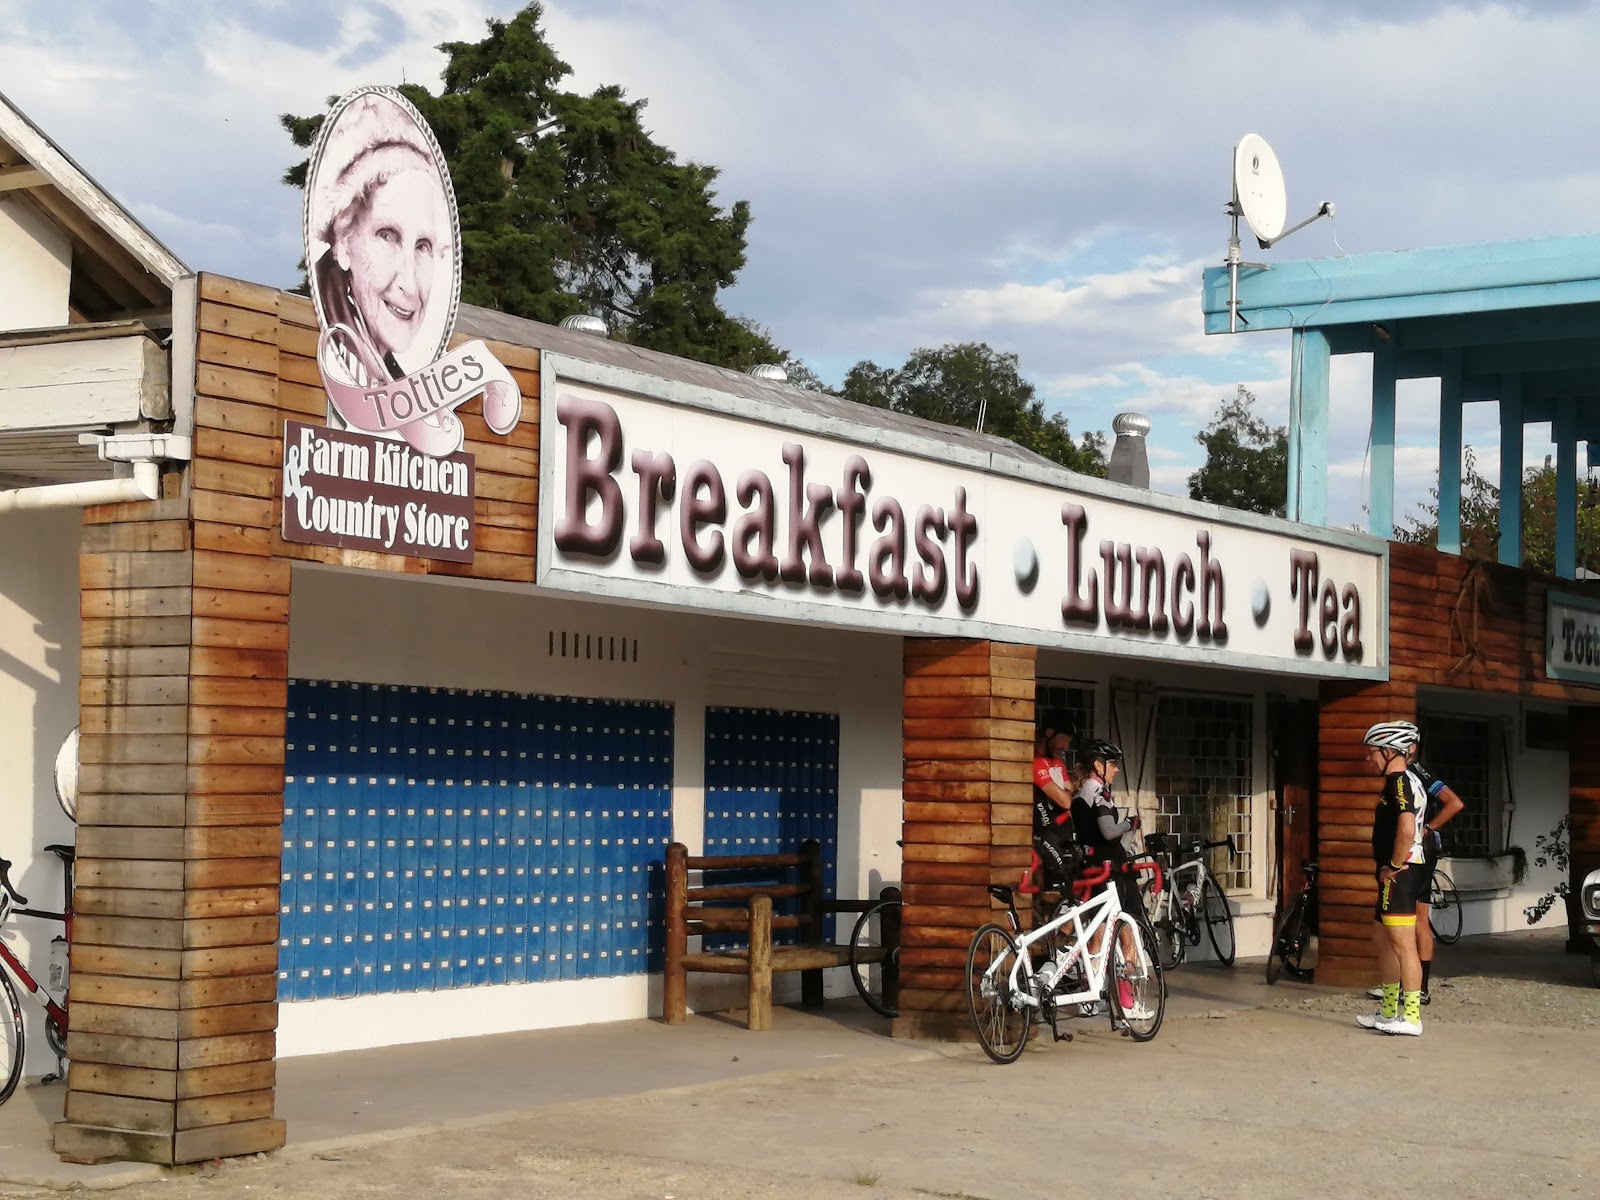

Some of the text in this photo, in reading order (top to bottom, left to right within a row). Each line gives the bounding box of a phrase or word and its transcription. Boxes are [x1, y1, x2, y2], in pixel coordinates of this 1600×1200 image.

[363, 355, 484, 427] Totties
[285, 445, 306, 498] &
[300, 427, 468, 497] Farm Kitchen
[297, 485, 469, 550] Country Store
[554, 394, 1362, 662] Breakfast Lunch Tea
